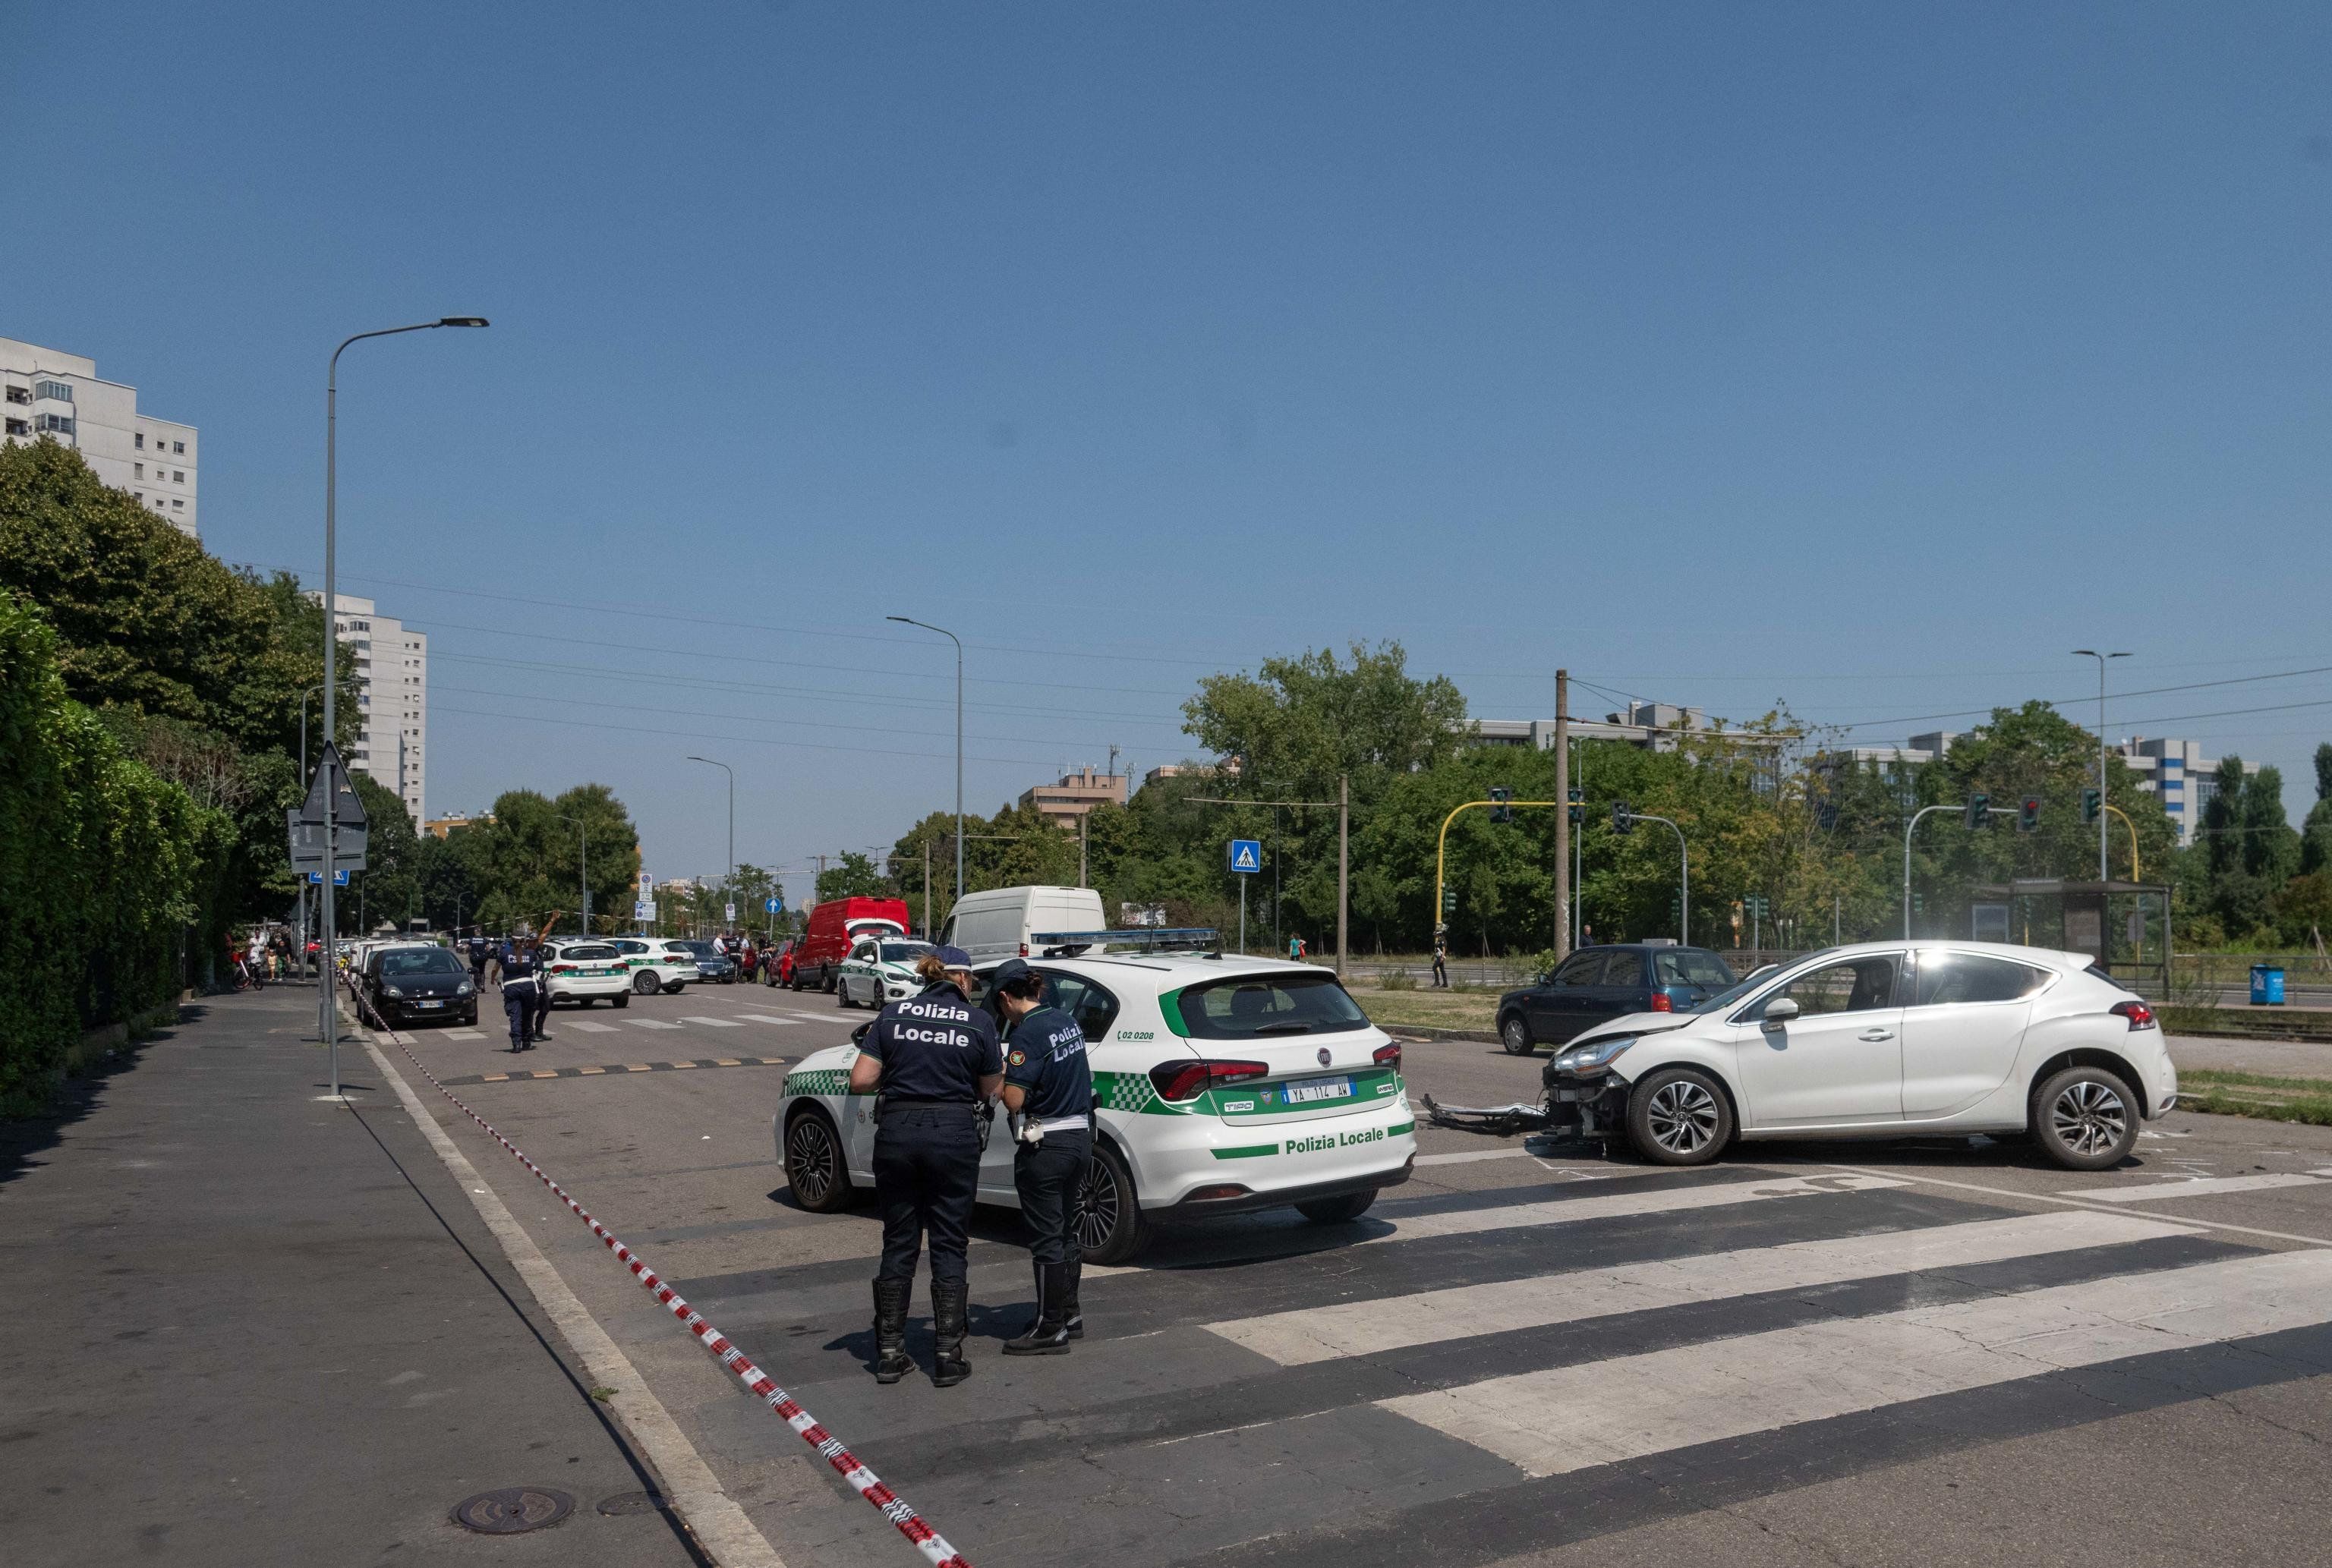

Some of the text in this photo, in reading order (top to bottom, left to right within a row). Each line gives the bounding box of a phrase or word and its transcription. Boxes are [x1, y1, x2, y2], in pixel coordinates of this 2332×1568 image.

[897, 1002, 969, 1022] Polizia
[893, 1024, 969, 1047] Locale
[1048, 1023, 1083, 1048] Polizi
[1293, 1088, 1305, 1101] YA
[1314, 1086, 1329, 1099] 114
[1225, 1102, 1253, 1110] TIPO
[1286, 1127, 1384, 1154] Polizia Locale
